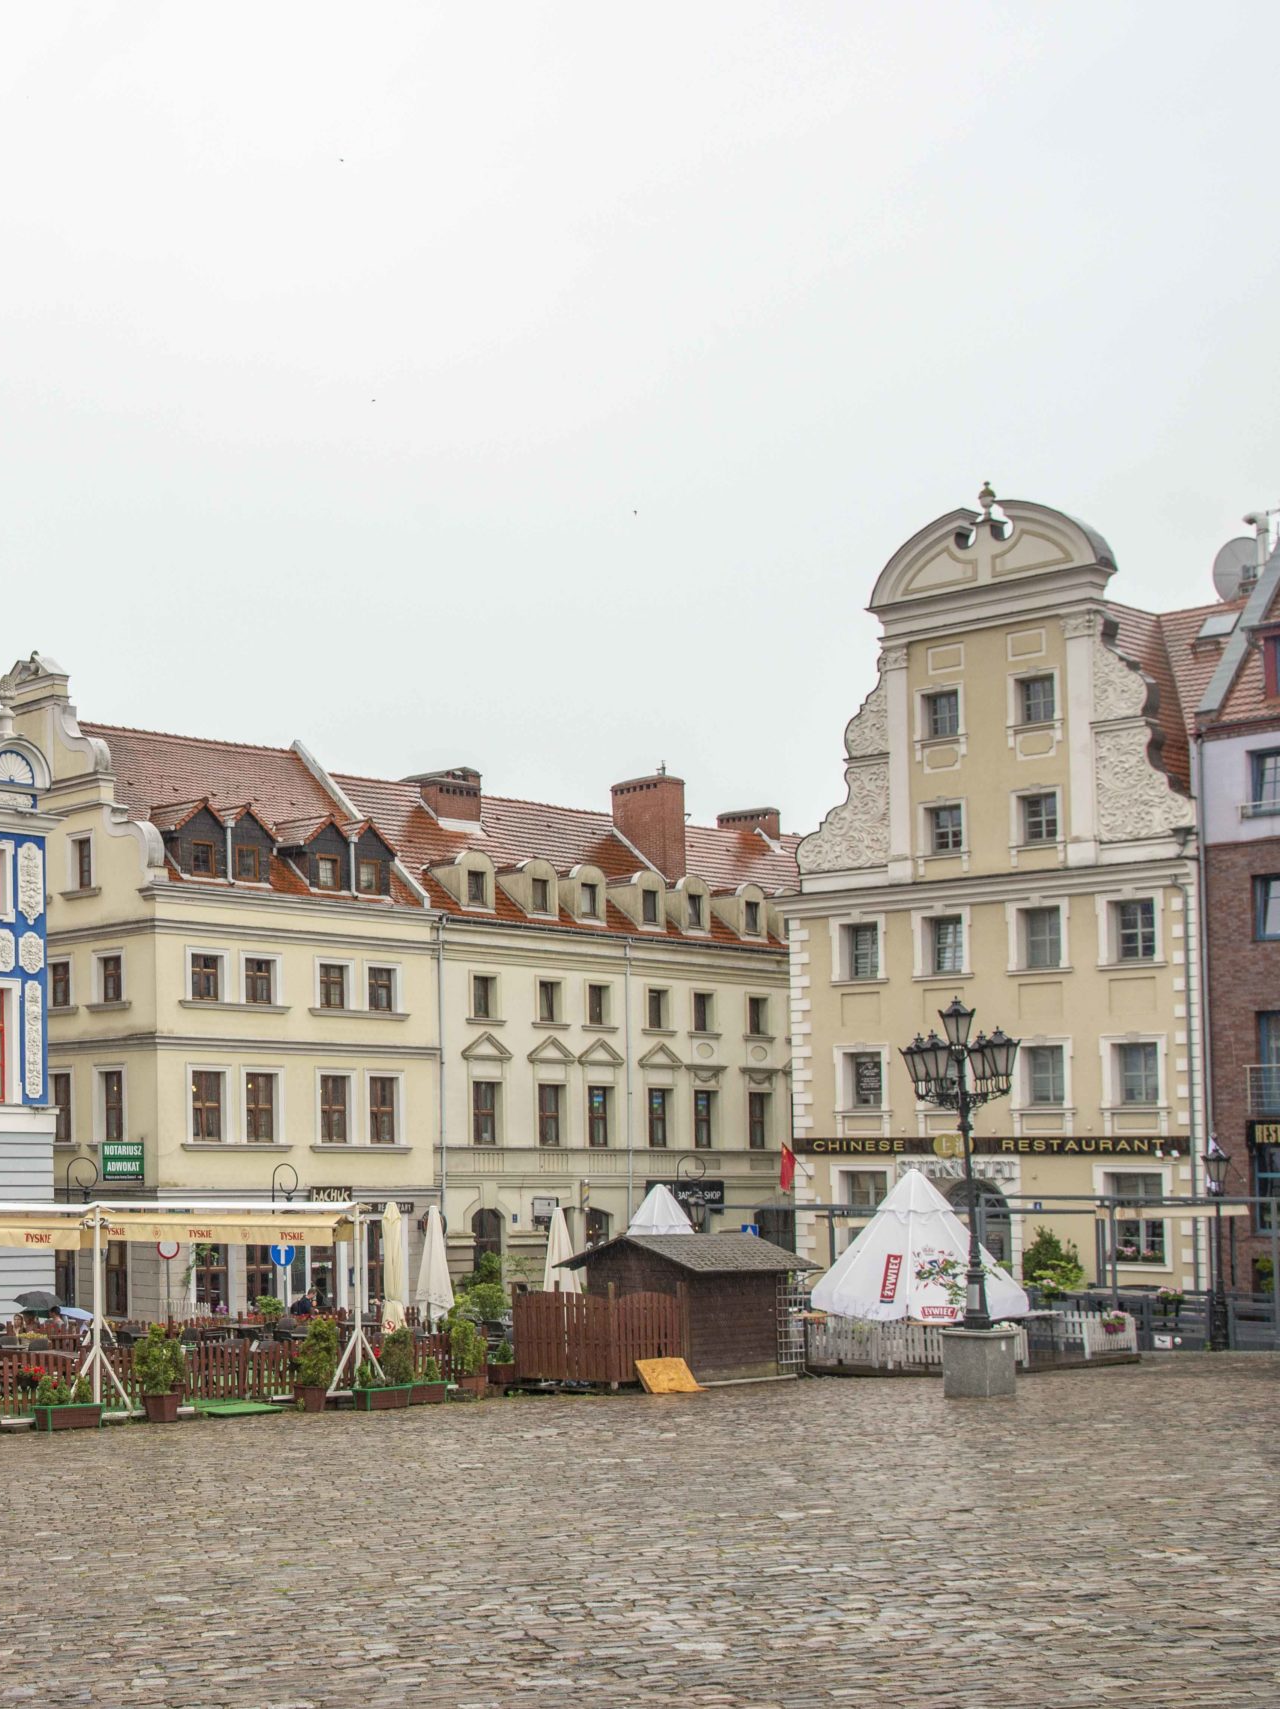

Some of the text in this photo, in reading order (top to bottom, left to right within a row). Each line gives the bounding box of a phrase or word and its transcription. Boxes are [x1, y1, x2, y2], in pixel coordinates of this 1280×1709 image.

[1255, 1124, 1280, 1143] RES
[104, 1145, 142, 1155] NOTARIUSZ
[812, 1139, 1165, 1151] CHINESE RESTAURANT
[107, 1161, 140, 1171] ADWOKAT
[704, 1191, 722, 1200] SHOP
[24, 1232, 52, 1243] TYSKIE
[107, 1227, 304, 1240] YSKIE TYSKIE TYSKIE
[884, 1256, 900, 1297] ŻYWIEC
